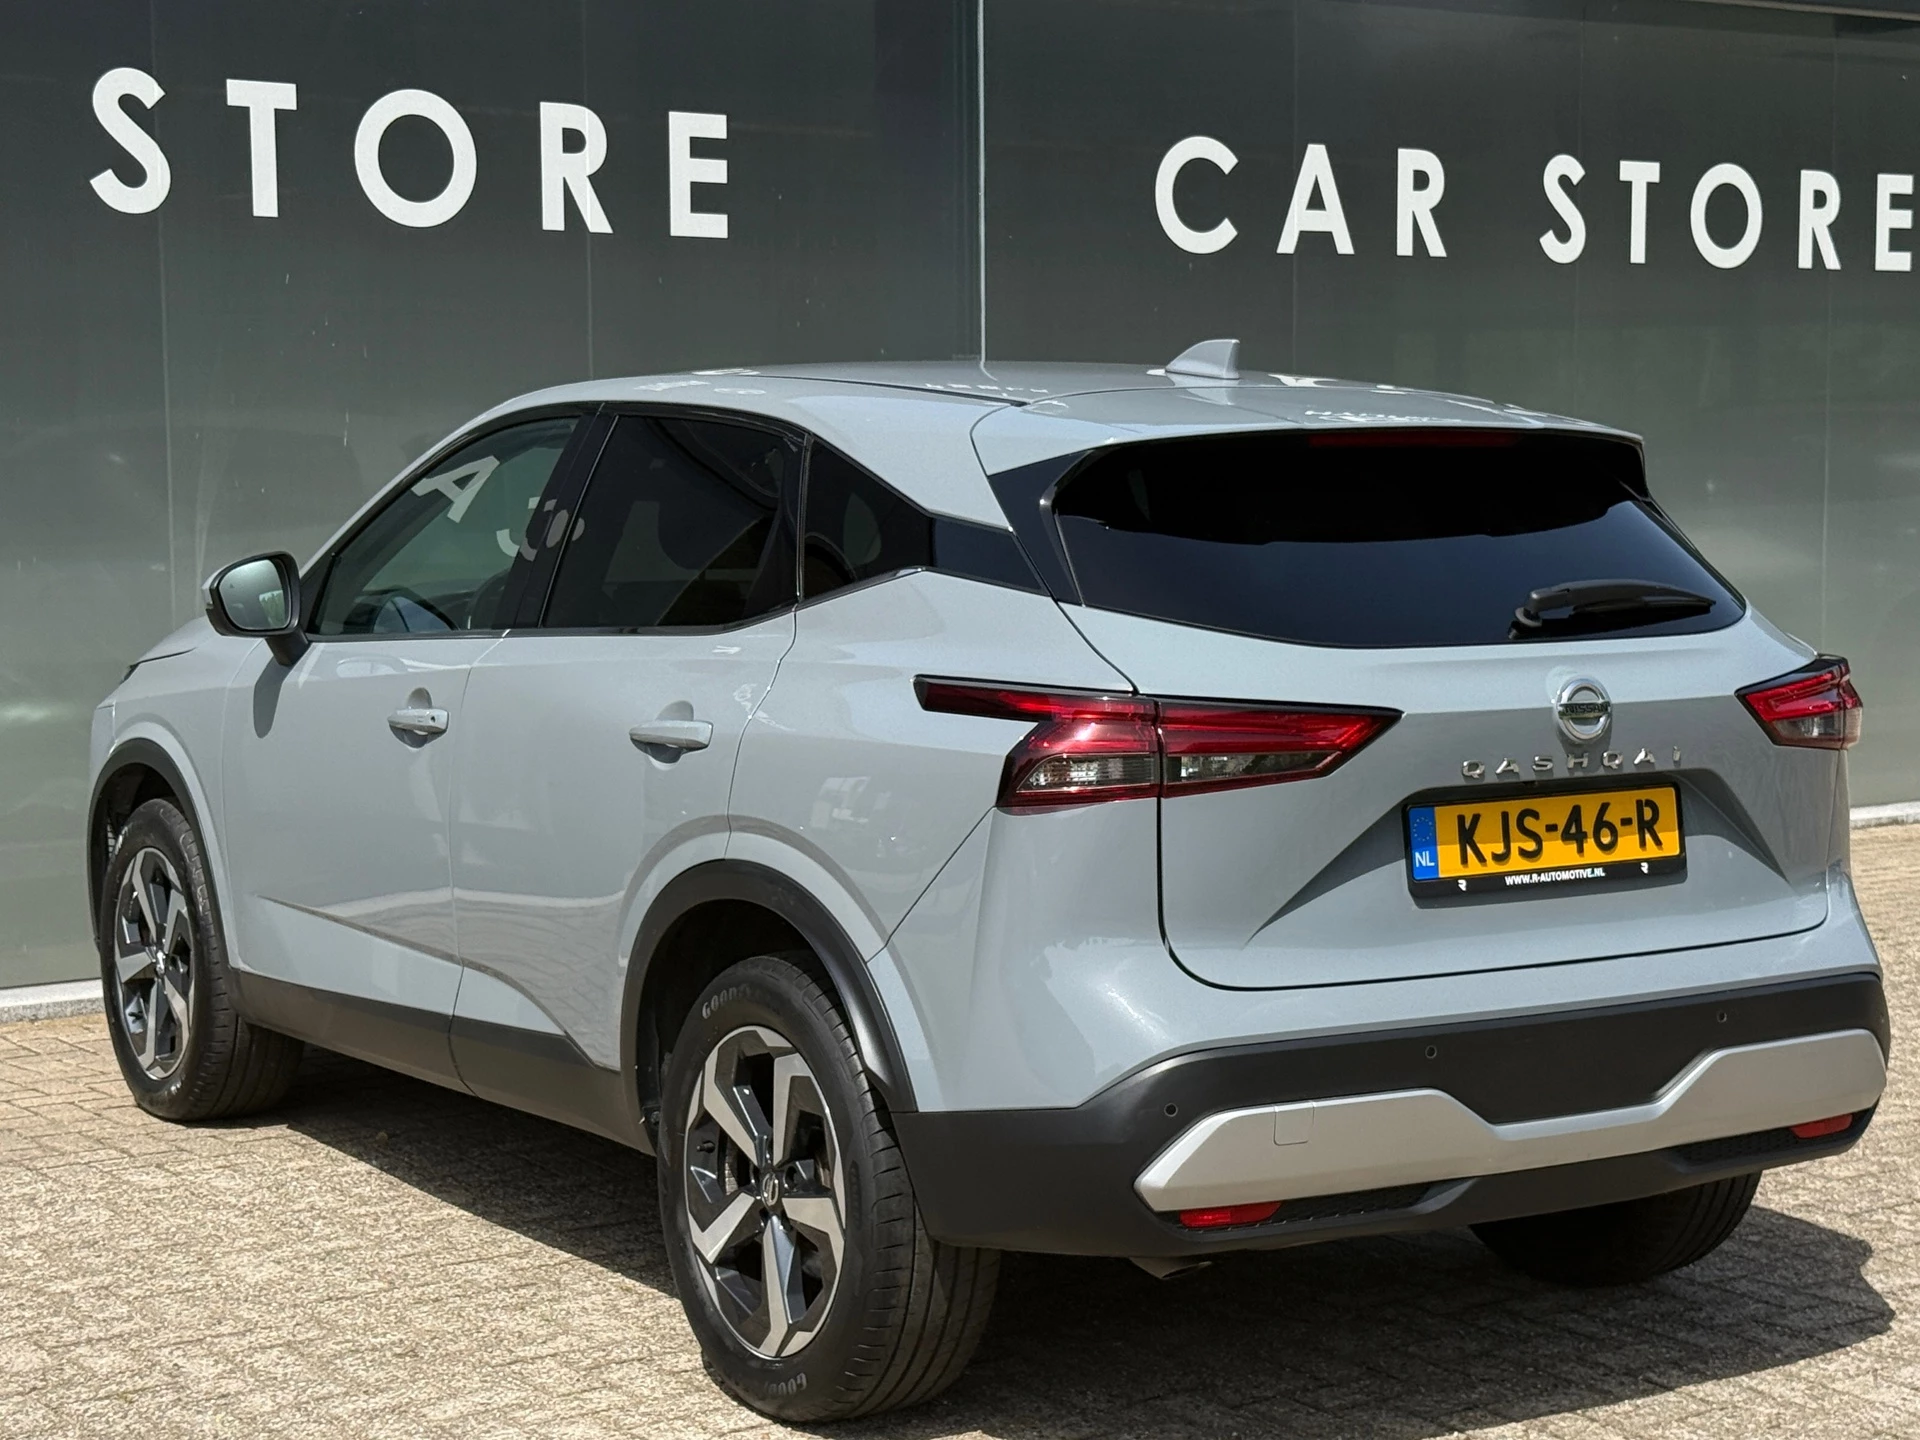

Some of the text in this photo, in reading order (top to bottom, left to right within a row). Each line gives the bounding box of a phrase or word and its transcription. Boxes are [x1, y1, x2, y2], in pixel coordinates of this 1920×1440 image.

[88, 67, 729, 239] STORE
[1154, 135, 1914, 272] CAR STORE
[1564, 702, 1609, 714] NISSAN
[1461, 746, 1682, 779] QASHQAI
[1456, 797, 1664, 868] KJS-46-R
[1414, 850, 1436, 868] NL
[1504, 867, 1606, 886] WWW.R-AUTOMOTIVE.NL
